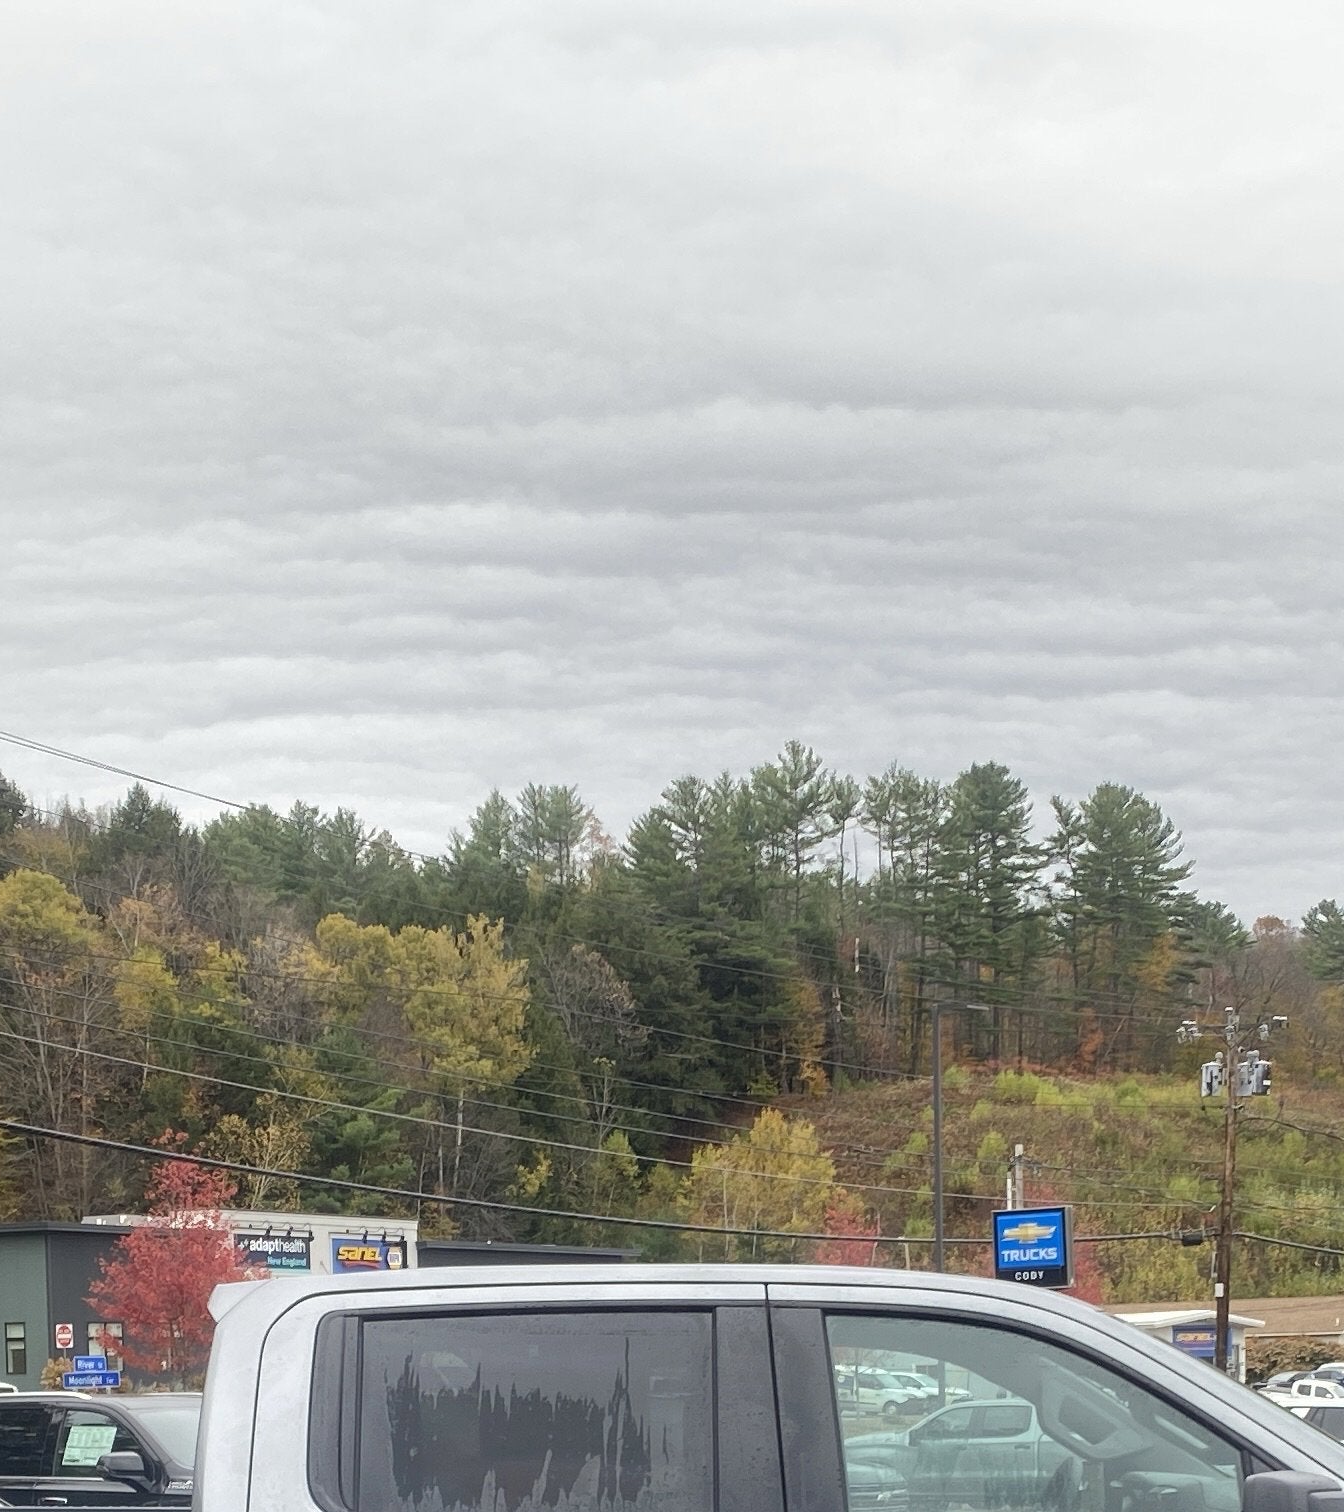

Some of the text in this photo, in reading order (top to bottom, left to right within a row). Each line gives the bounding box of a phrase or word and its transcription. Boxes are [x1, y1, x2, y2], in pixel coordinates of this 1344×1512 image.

[249, 1237, 306, 1254] adapthealth
[1001, 1247, 1057, 1262] TRUCKS
[282, 1257, 307, 1267] England
[1015, 1271, 1044, 1280] CODY
[77, 1359, 95, 1369] River
